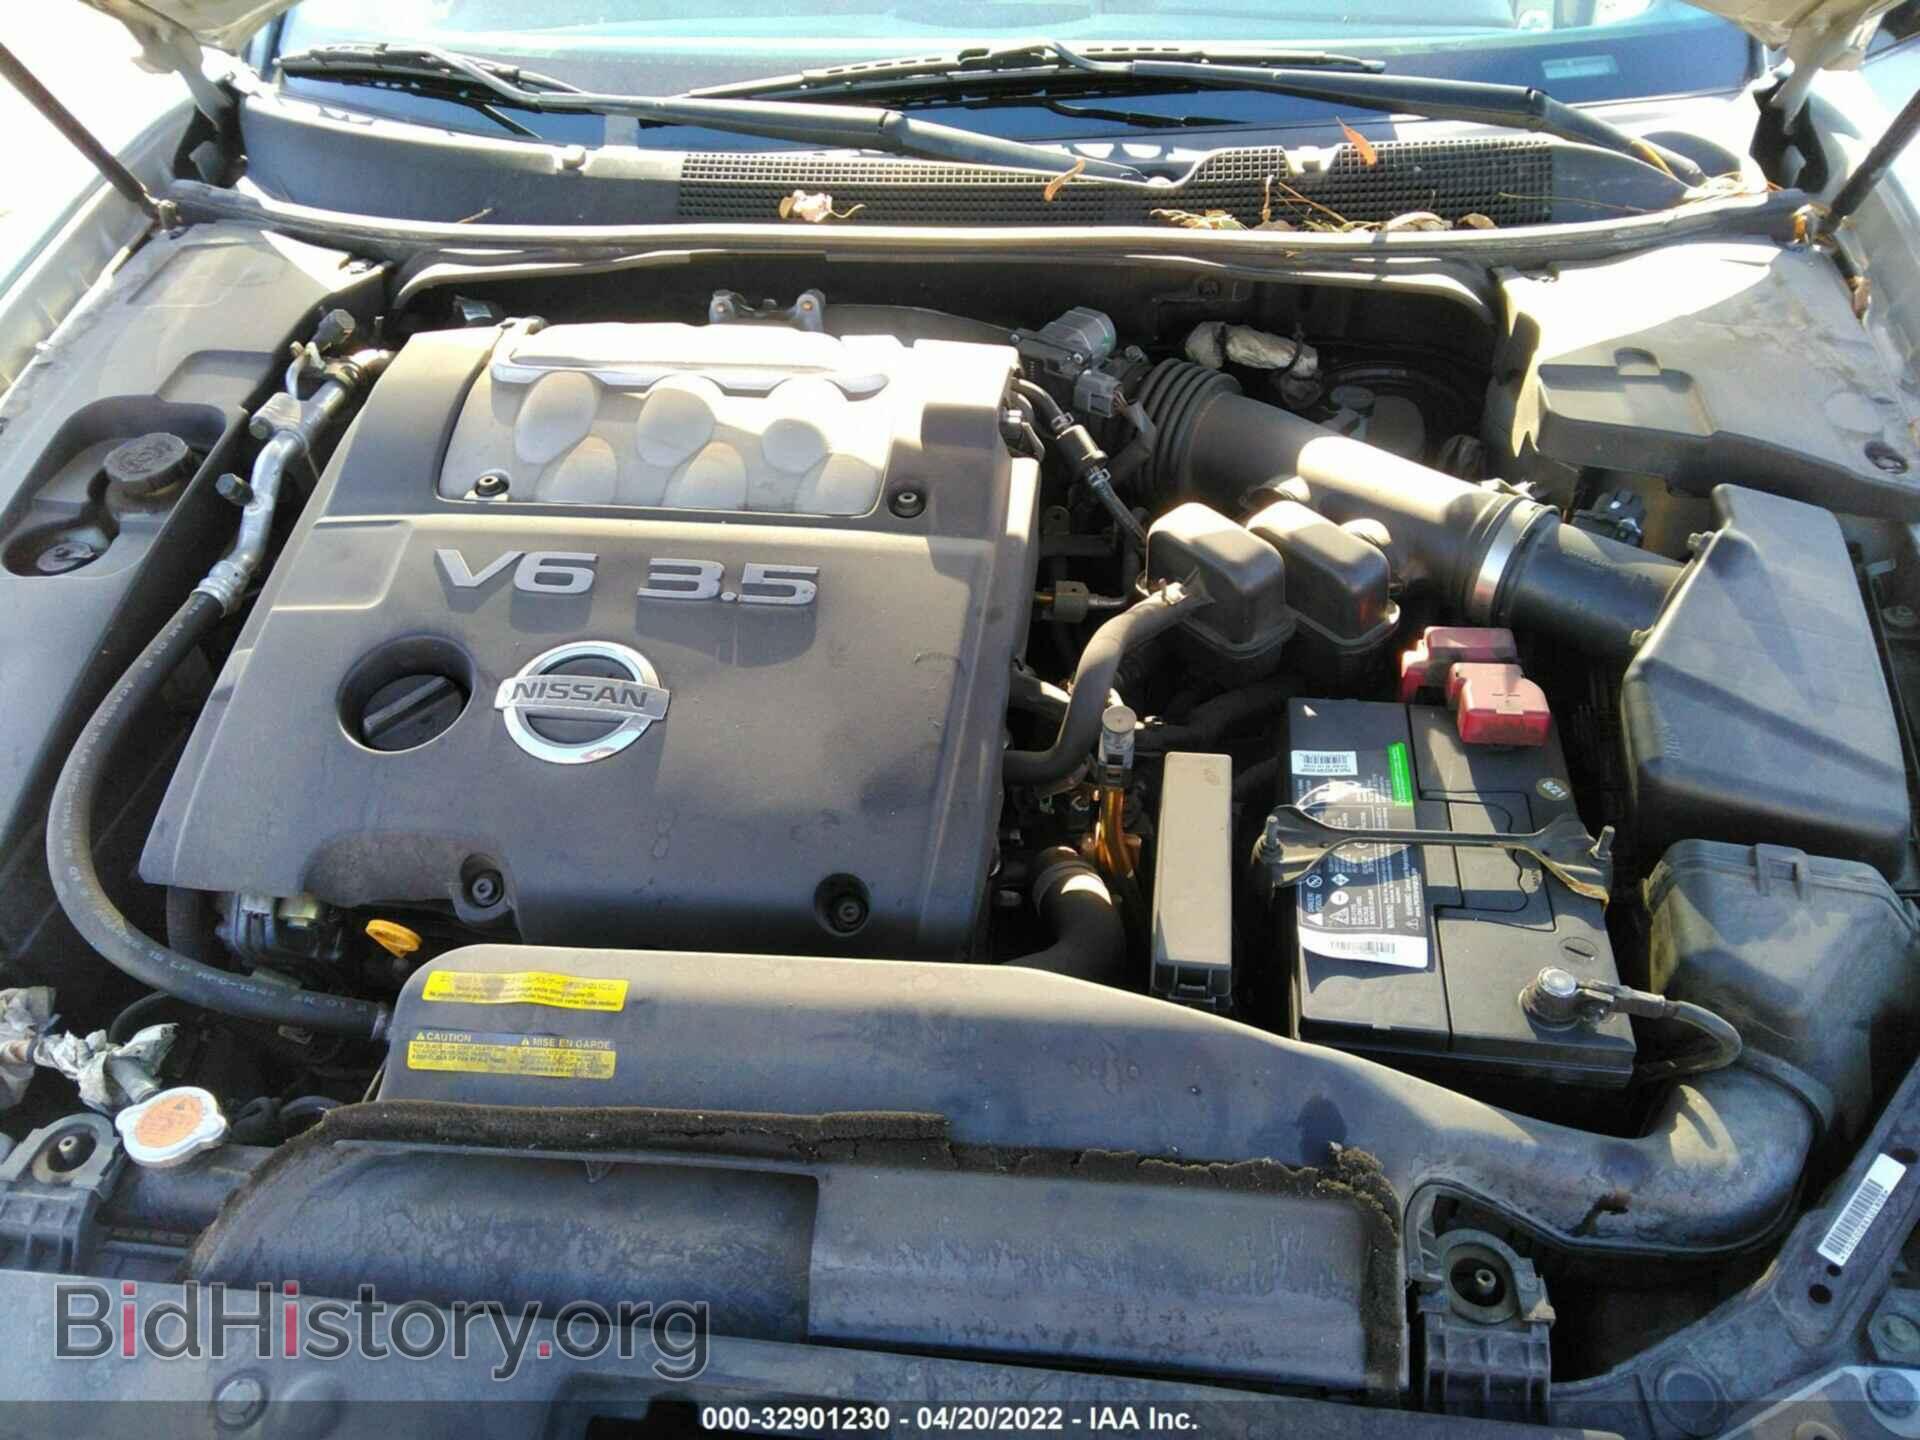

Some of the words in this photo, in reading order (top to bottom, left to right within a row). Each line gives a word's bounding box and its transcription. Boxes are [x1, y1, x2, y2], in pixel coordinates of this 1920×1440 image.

[434, 548, 600, 595] V6
[636, 557, 820, 607] 3.5
[511, 681, 648, 708] NISSAN
[426, 1032, 472, 1043] CAUTION
